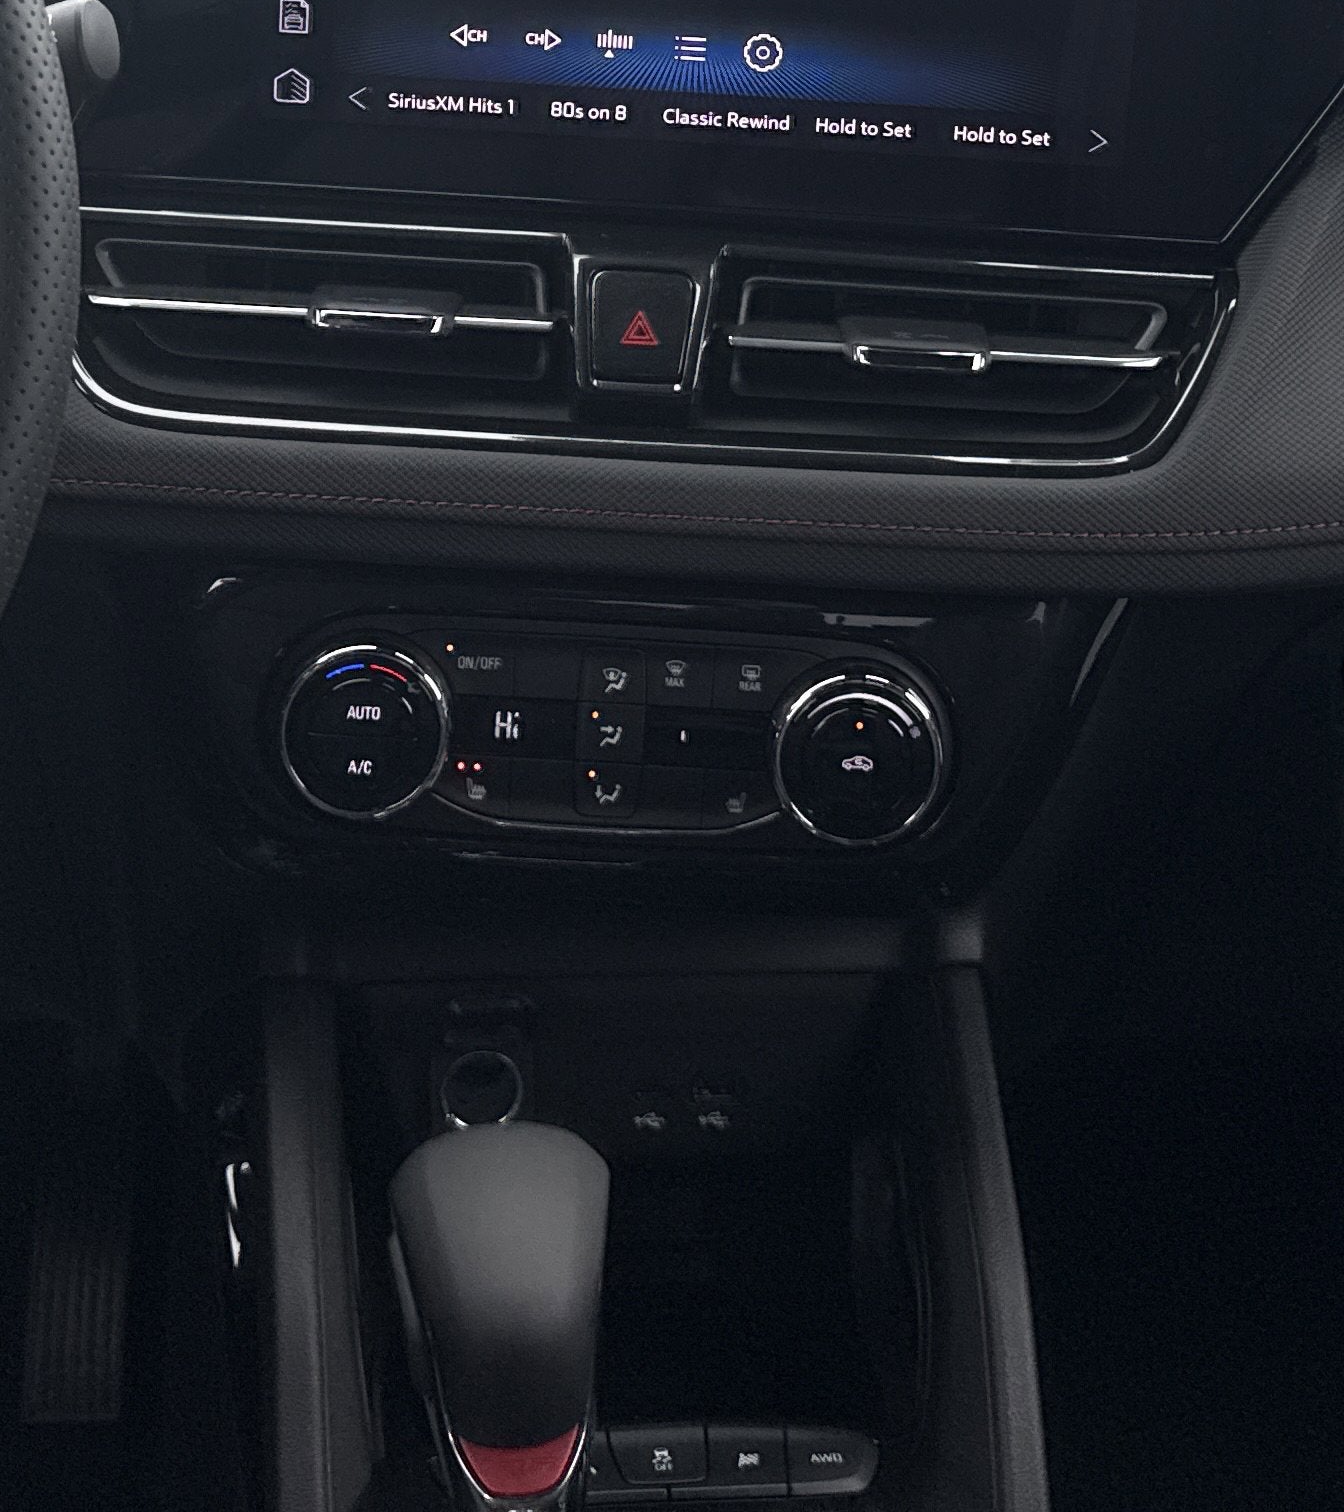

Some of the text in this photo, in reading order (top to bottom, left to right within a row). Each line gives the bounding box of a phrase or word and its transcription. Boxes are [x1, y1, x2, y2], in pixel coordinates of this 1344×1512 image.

[467, 29, 487, 42] CH
[525, 32, 544, 45] CH
[388, 93, 515, 115] SiriusXM Hits 1
[550, 102, 627, 120] 80s on 8
[662, 110, 790, 130] Classic Rewind
[815, 118, 912, 138] Hold to Set
[953, 126, 1050, 147] Hold to Set
[457, 656, 503, 670] ON/OFF
[664, 676, 685, 687] MAX
[738, 680, 762, 692] REAR
[345, 705, 381, 722] AUTO
[494, 710, 520, 739] Hi
[347, 760, 373, 777] A/C
[809, 1452, 843, 1464] AWD
